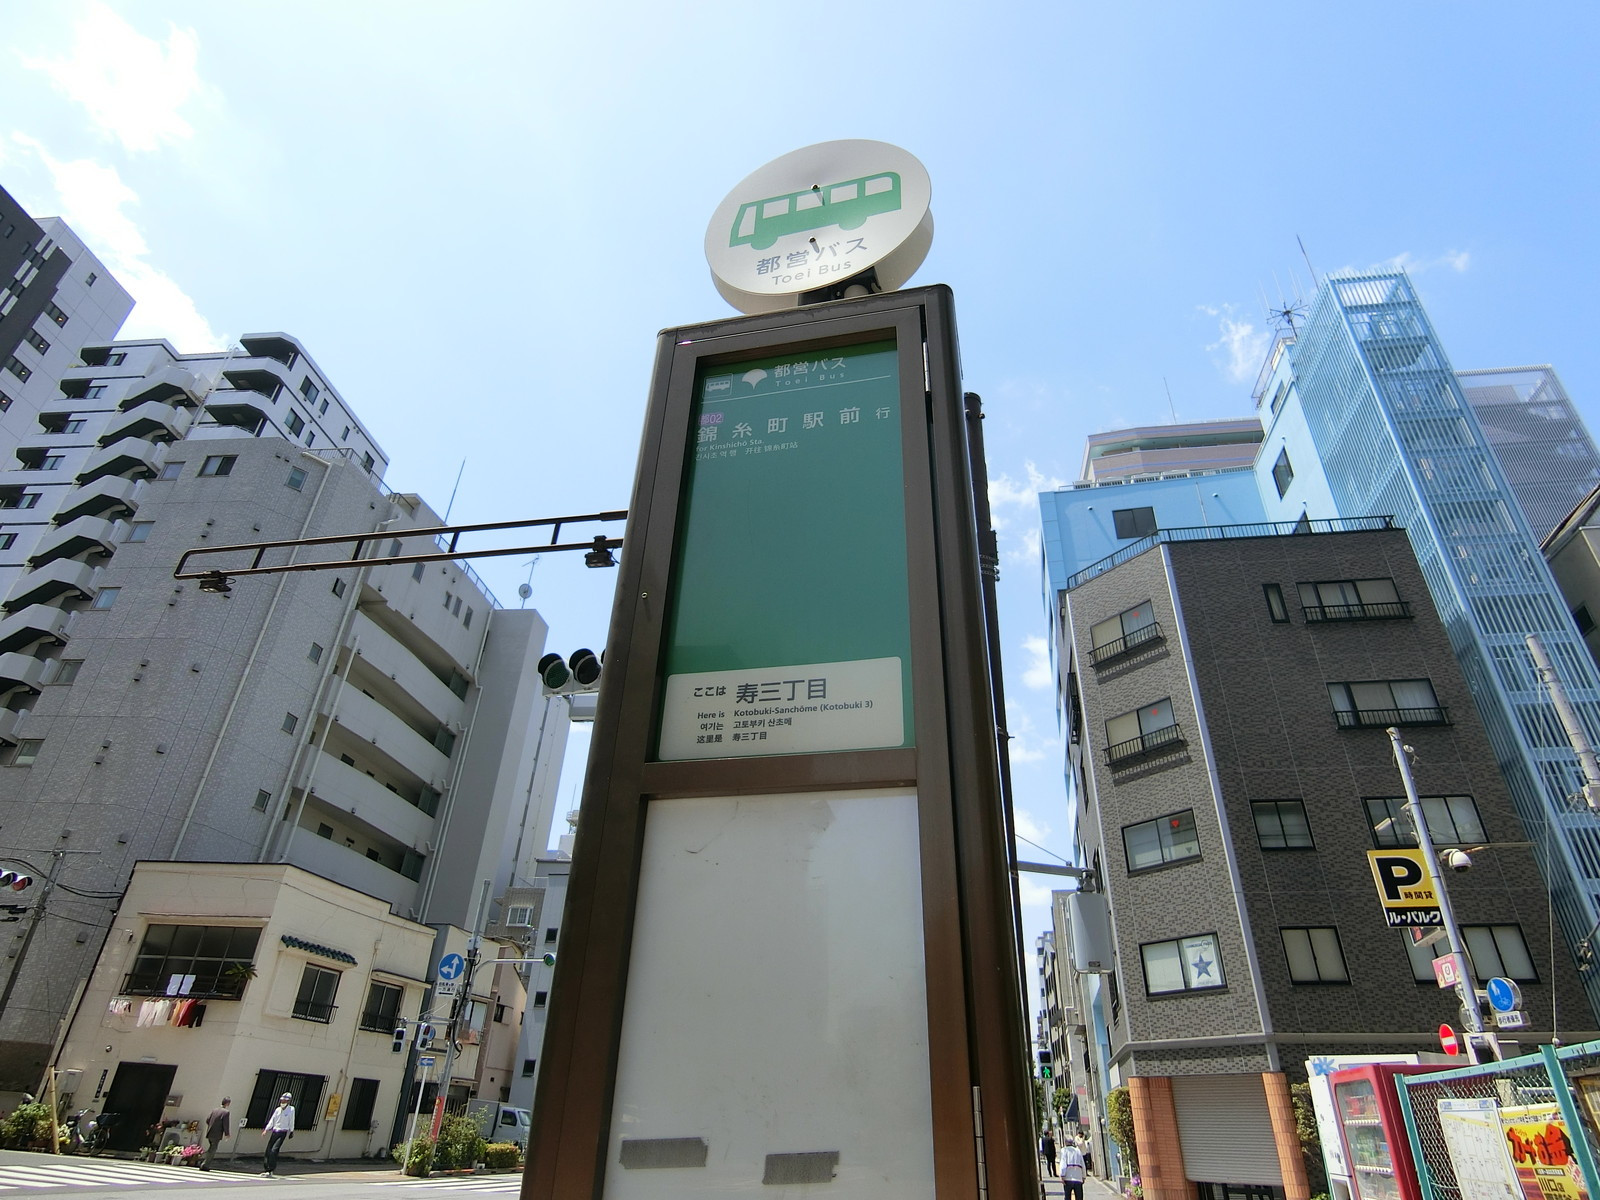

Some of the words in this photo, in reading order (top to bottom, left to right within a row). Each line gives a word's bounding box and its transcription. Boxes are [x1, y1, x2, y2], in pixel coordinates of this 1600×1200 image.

[756, 237, 868, 275] 都営バス
[772, 268, 811, 285] Toei
[819, 260, 852, 275] Bus
[774, 357, 846, 378] 都営バス
[775, 375, 808, 387] Toei
[819, 372, 845, 381] Bus
[693, 685, 727, 698] ここは
[736, 677, 828, 704] 寿三丁目
[820, 700, 863, 712] (Kotobuki
[864, 700, 873, 709] 3)
[697, 711, 717, 719] Here
[718, 710, 725, 718] is
[700, 722, 724, 731] 여기는
[696, 734, 723, 744] 这里是
[732, 731, 767, 741] 寿三丁目
[1375, 857, 1422, 900] P
[1404, 890, 1434, 900] 時間貸
